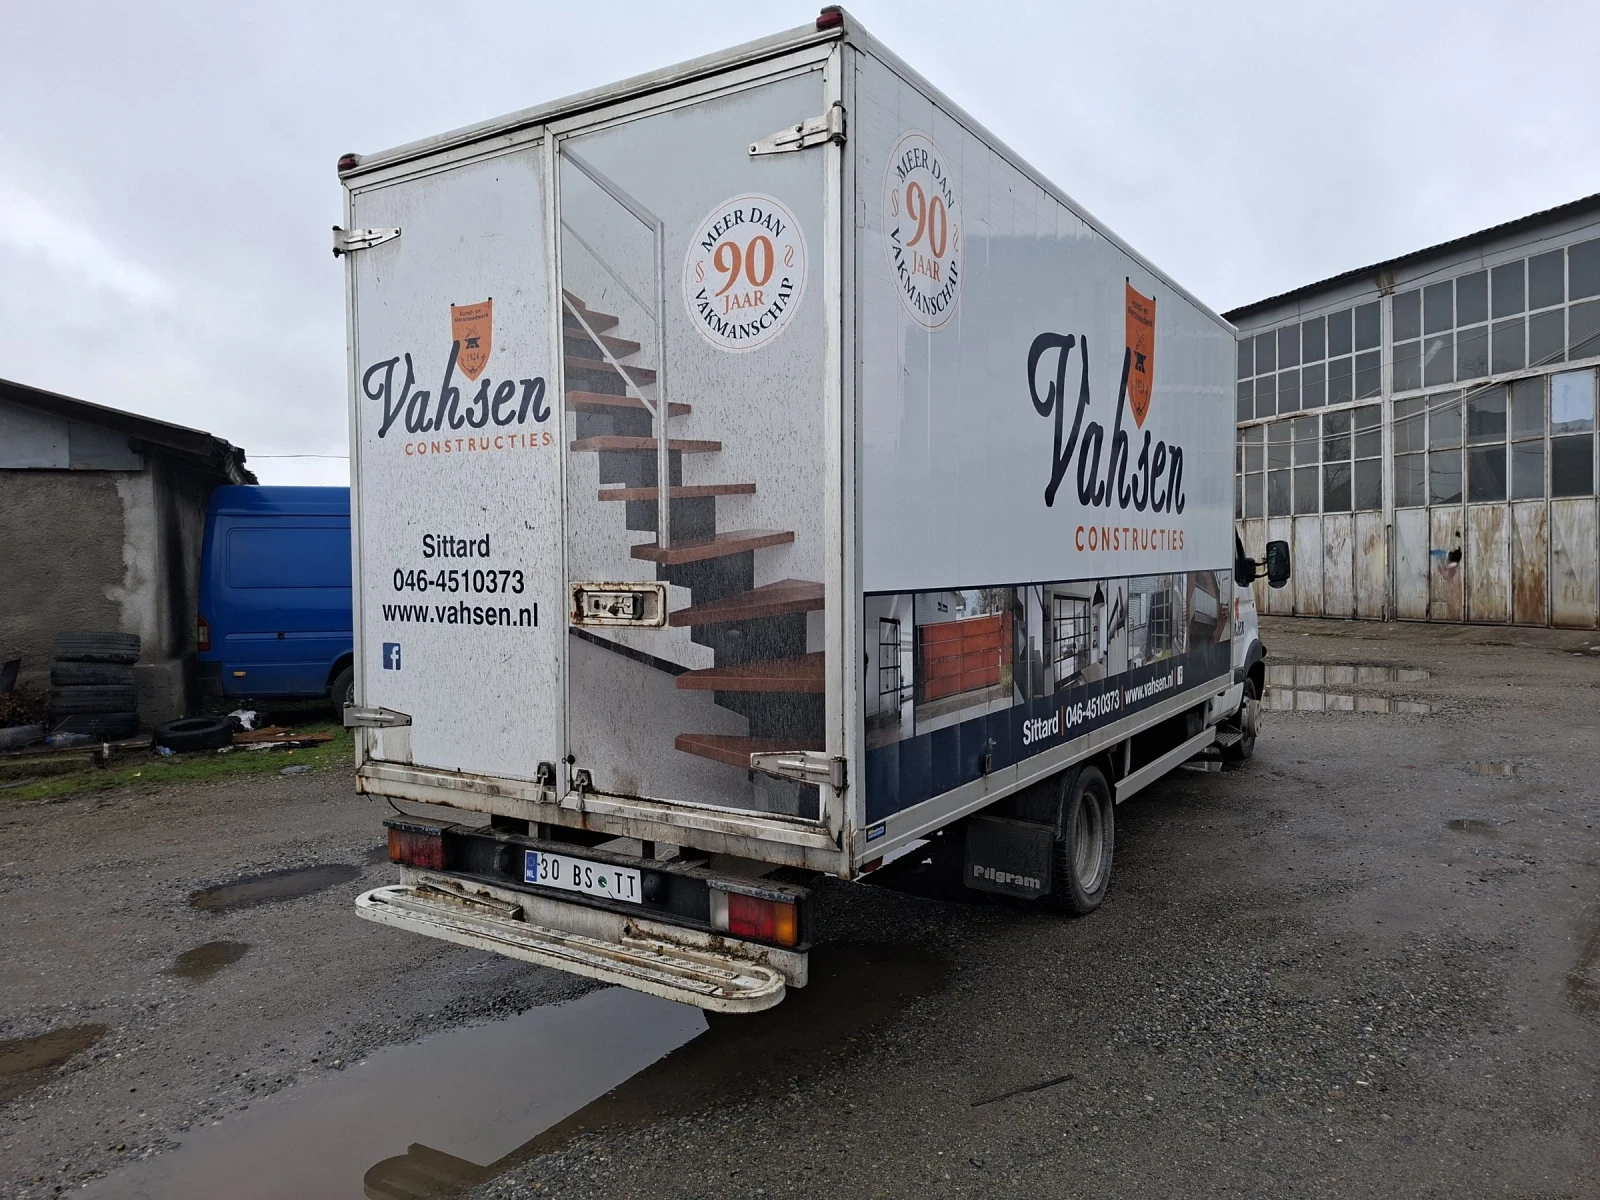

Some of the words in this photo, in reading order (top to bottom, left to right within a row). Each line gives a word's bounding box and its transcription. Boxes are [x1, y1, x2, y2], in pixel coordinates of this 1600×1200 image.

[895, 148, 929, 184] MEER
[931, 158, 955, 210] DAN
[701, 209, 745, 254] MEER
[749, 207, 786, 238] DAN
[905, 181, 947, 259] 90
[713, 235, 775, 297] 90
[890, 227, 958, 315] VAKMANSCHAP
[912, 250, 941, 282] JAAR
[695, 277, 794, 339] VAKMANSCHAP
[723, 290, 765, 316] JAAR
[362, 339, 551, 439] Vahsen
[1027, 332, 1185, 515] Vahsen
[404, 431, 551, 456] CONSTRUCTIES
[422, 533, 491, 559] Sittard
[1075, 525, 1185, 552] CONSTRUCTIES
[393, 568, 525, 594] 046-4510373
[382, 600, 539, 628] www.vahsen.nl
[1022, 711, 1060, 746] Sittard
[1065, 689, 1120, 729] 046-4510373
[1124, 669, 1174, 705] www.vahsen.nl
[526, 869, 535, 879] NL
[573, 864, 593, 889] BS
[614, 871, 636, 897] TT
[973, 864, 1041, 889] Pilgram
